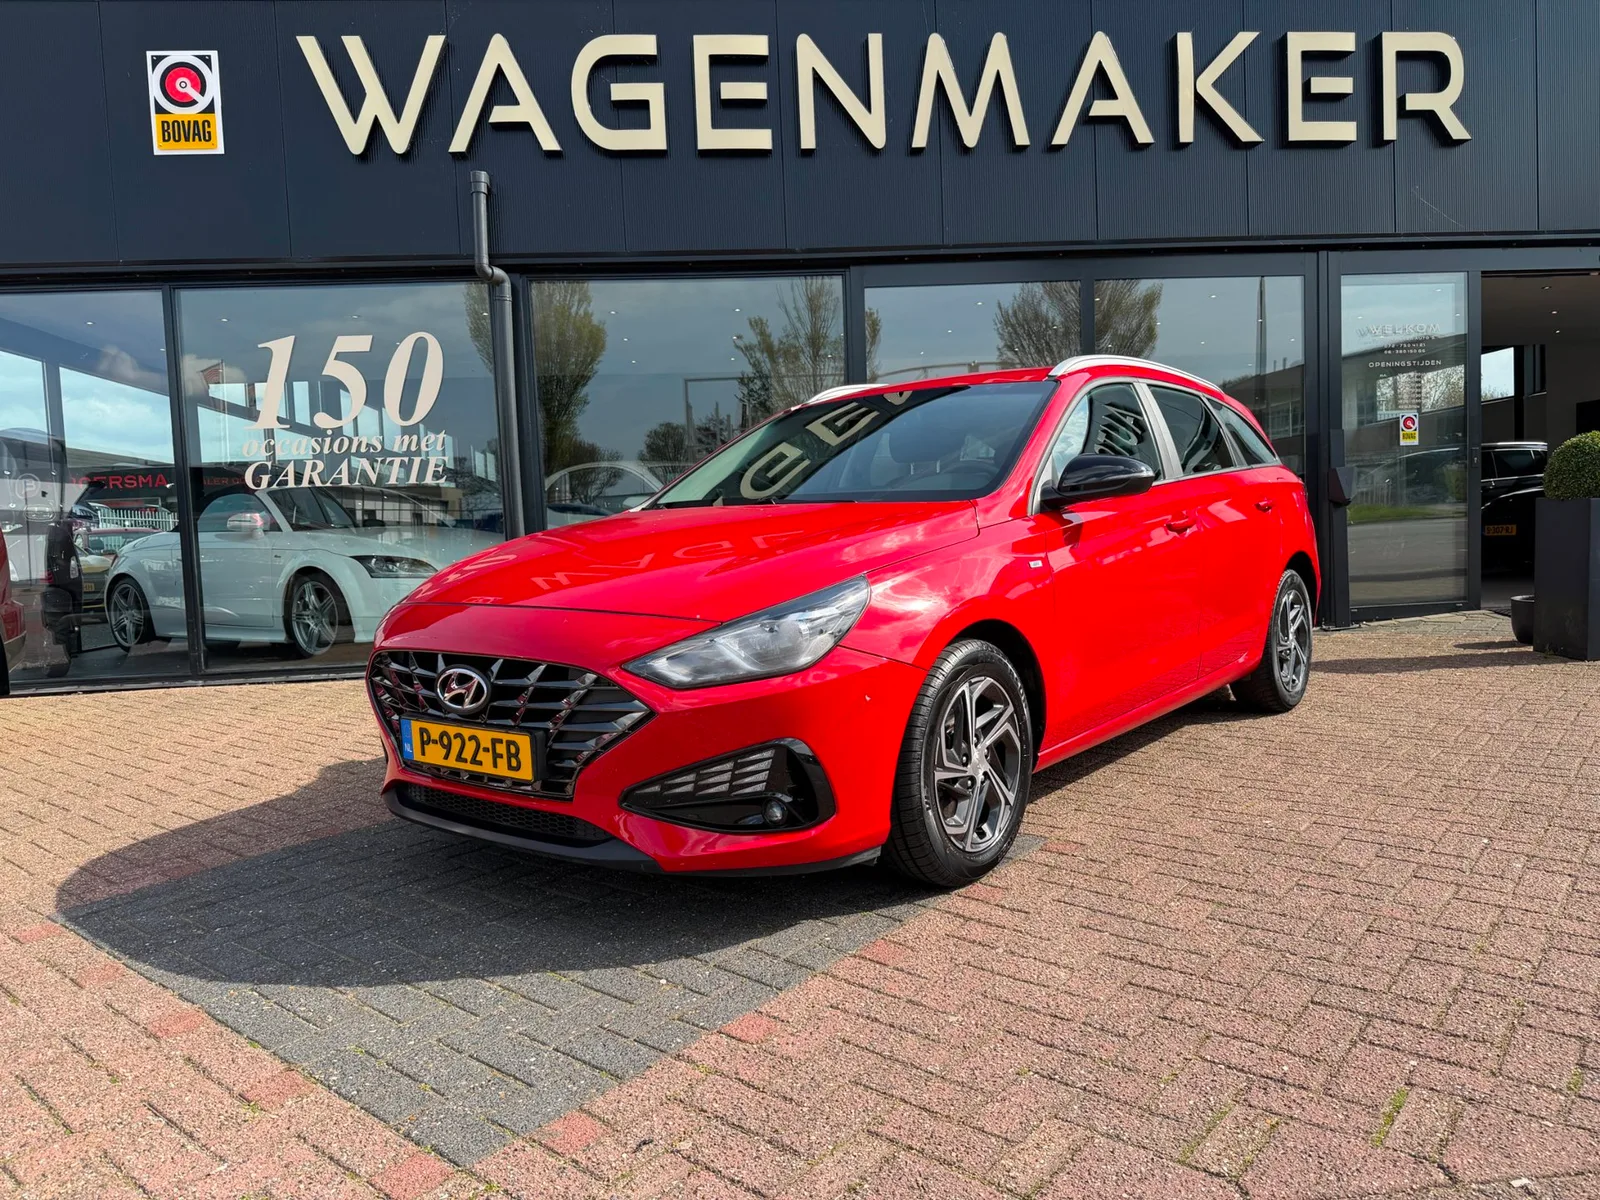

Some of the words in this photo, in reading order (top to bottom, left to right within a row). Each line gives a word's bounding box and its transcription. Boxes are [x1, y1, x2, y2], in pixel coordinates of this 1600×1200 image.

[296, 30, 1472, 155] WAGENMAKER
[161, 119, 212, 143] BOVAG
[1369, 323, 1440, 334] WELKOM
[1368, 360, 1442, 368] OPENINGSTIJDEN
[244, 331, 444, 429] 150
[242, 429, 382, 457] occasions
[391, 429, 447, 453] met
[244, 456, 450, 490] GARANTIE
[418, 726, 522, 772] P-922-FB
